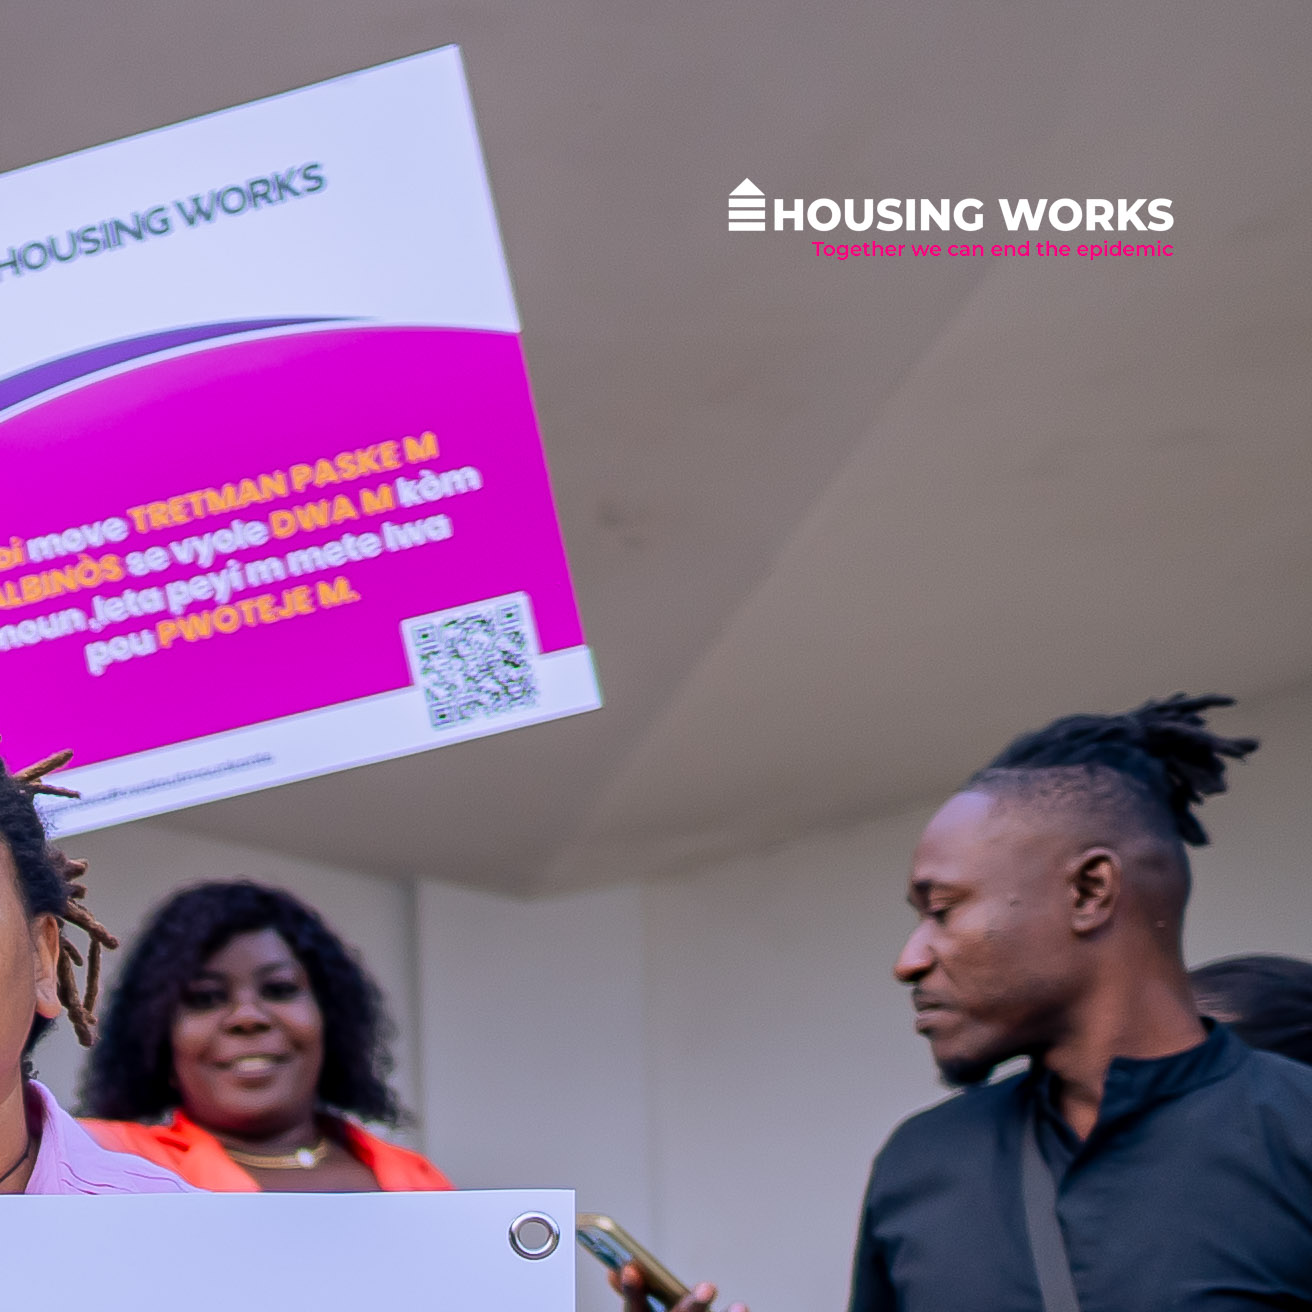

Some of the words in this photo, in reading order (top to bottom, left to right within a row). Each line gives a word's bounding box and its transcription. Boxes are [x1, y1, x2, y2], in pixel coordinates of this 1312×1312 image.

[176, 163, 328, 227] WORKS
[27, 517, 129, 562] move
[127, 470, 288, 534] TRETMAN
[290, 440, 403, 492] PASKE
[403, 431, 440, 464] M
[126, 546, 170, 576] se
[169, 519, 270, 568] vyole
[269, 494, 360, 539] DWA
[359, 483, 395, 516] M
[395, 466, 483, 508] kòm
[165, 559, 246, 615] peyi
[245, 556, 286, 588] m
[286, 531, 385, 577] mete
[382, 513, 453, 552] lwa
[84, 629, 158, 677] pou
[156, 585, 316, 648] PWOTEJE
